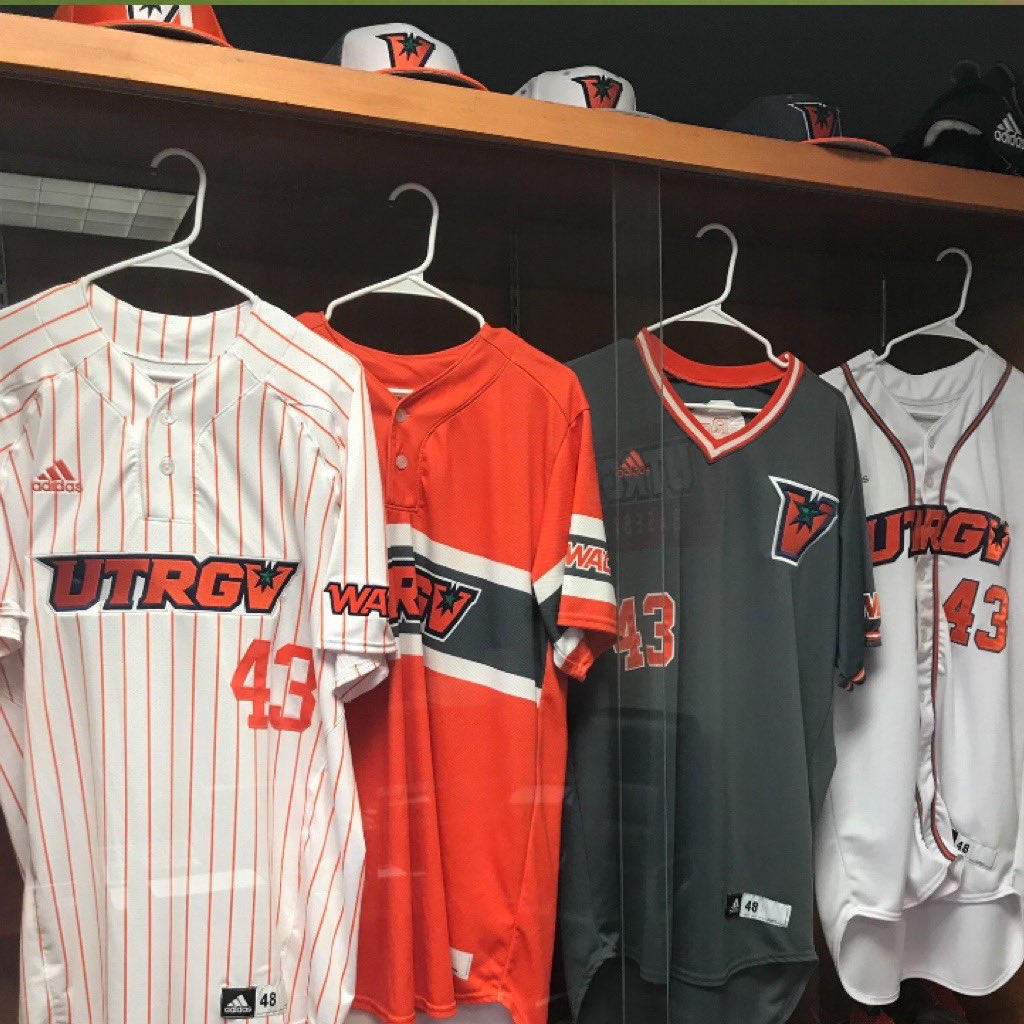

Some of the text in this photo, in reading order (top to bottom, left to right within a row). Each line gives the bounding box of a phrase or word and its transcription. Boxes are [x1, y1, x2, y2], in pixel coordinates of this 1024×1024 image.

[31, 480, 82, 494] adidas
[32, 553, 299, 613] UTRGV
[613, 592, 675, 671] 43
[943, 578, 1010, 653] 43
[230, 639, 318, 732] 43
[957, 841, 970, 853] 48
[744, 900, 759, 913] 48
[260, 991, 277, 1007] 48
